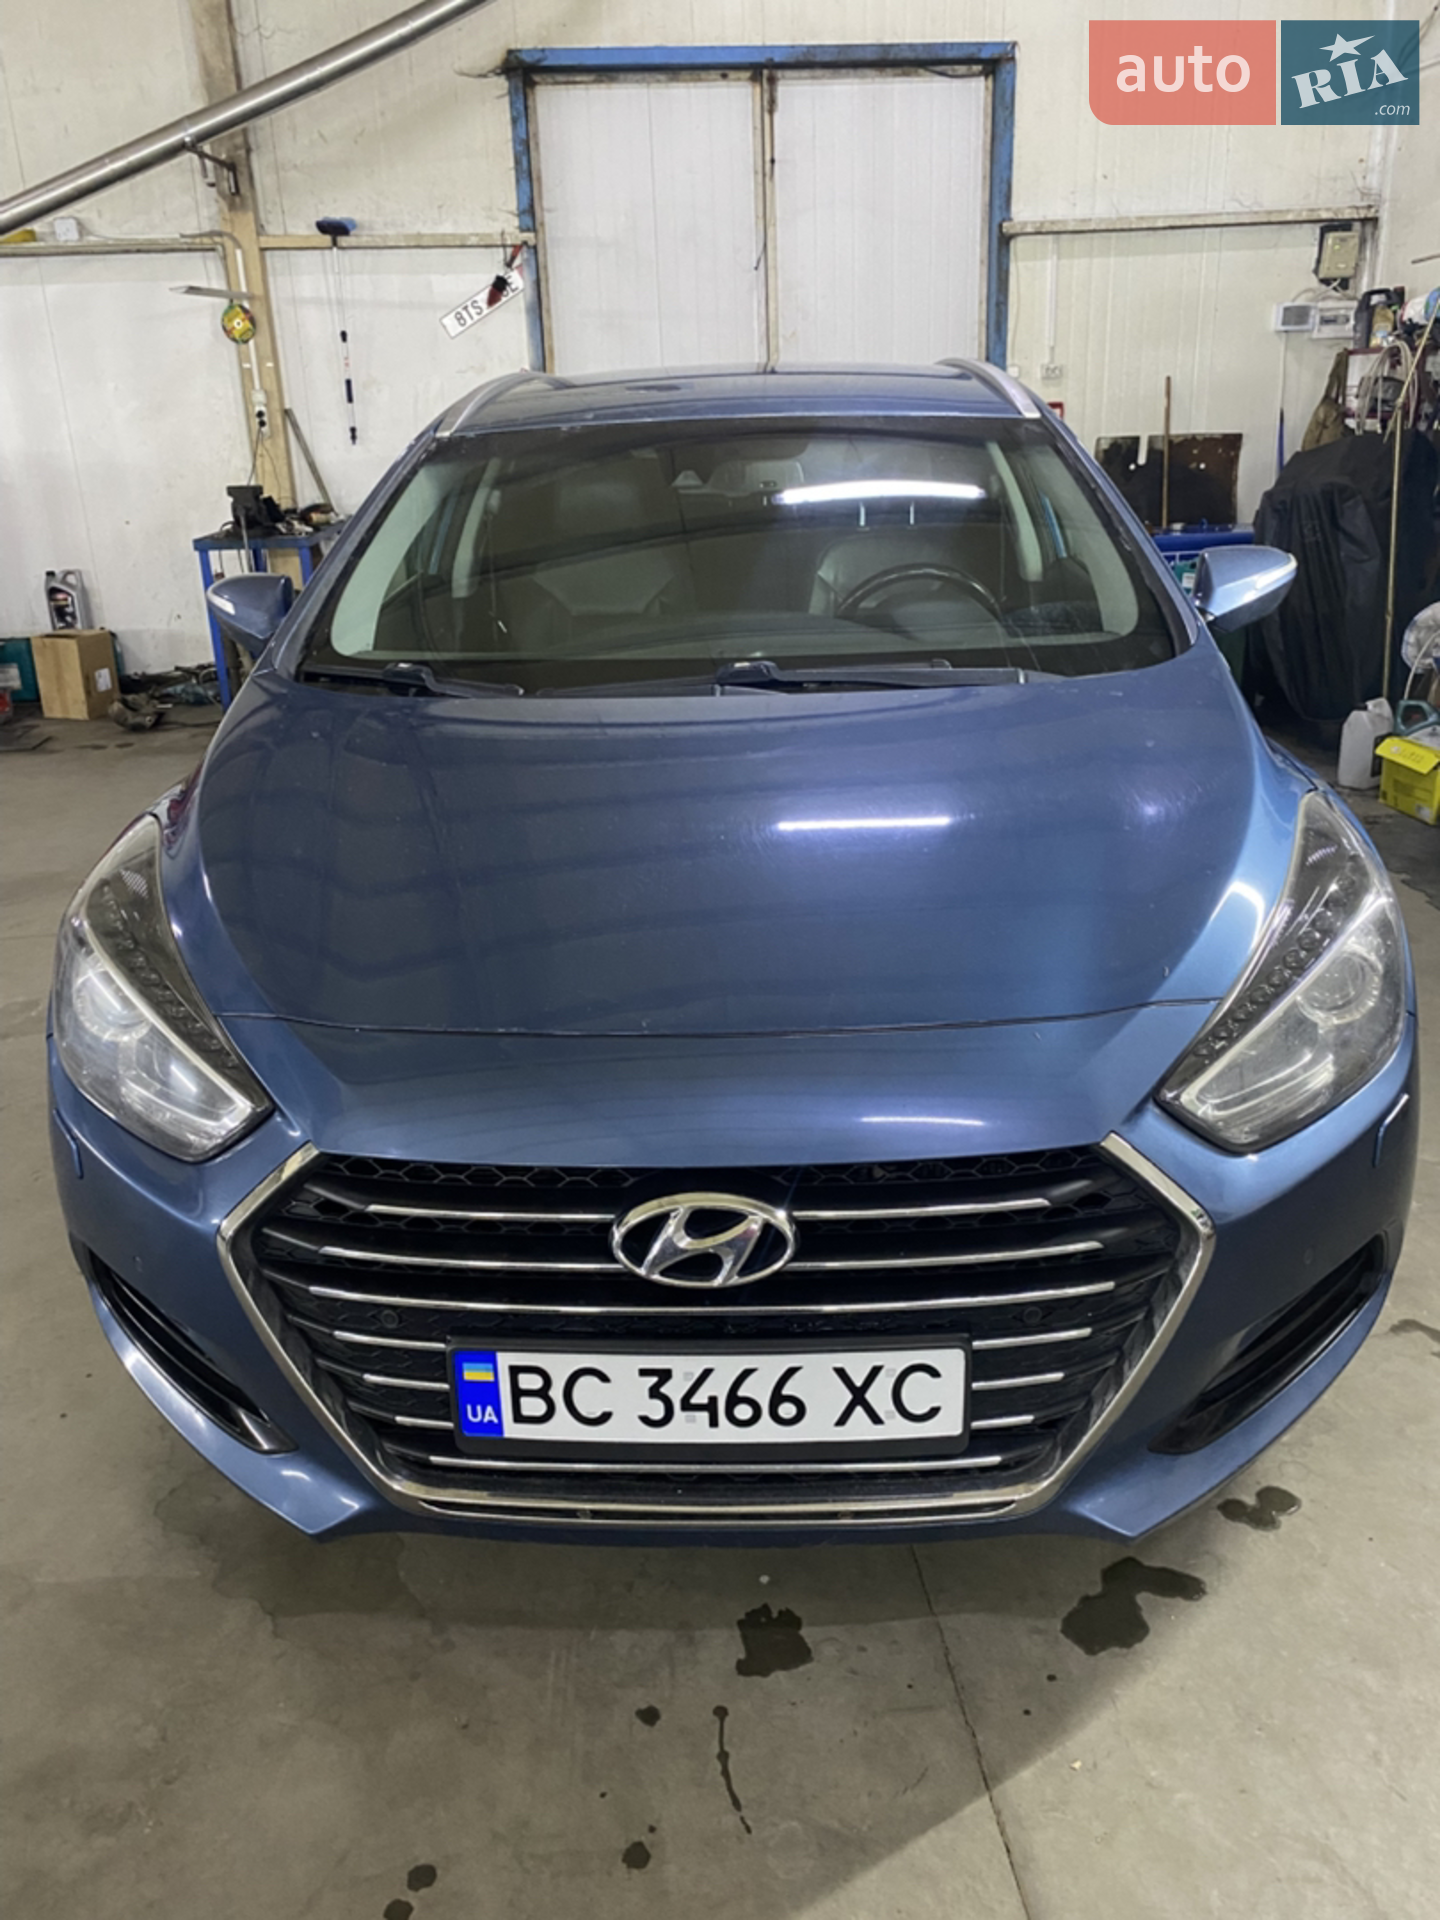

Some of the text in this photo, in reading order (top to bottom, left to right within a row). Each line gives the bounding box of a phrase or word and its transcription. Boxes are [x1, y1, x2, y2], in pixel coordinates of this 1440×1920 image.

[466, 1405, 498, 1424] UA
[508, 1363, 942, 1428] BC 3466 XC
